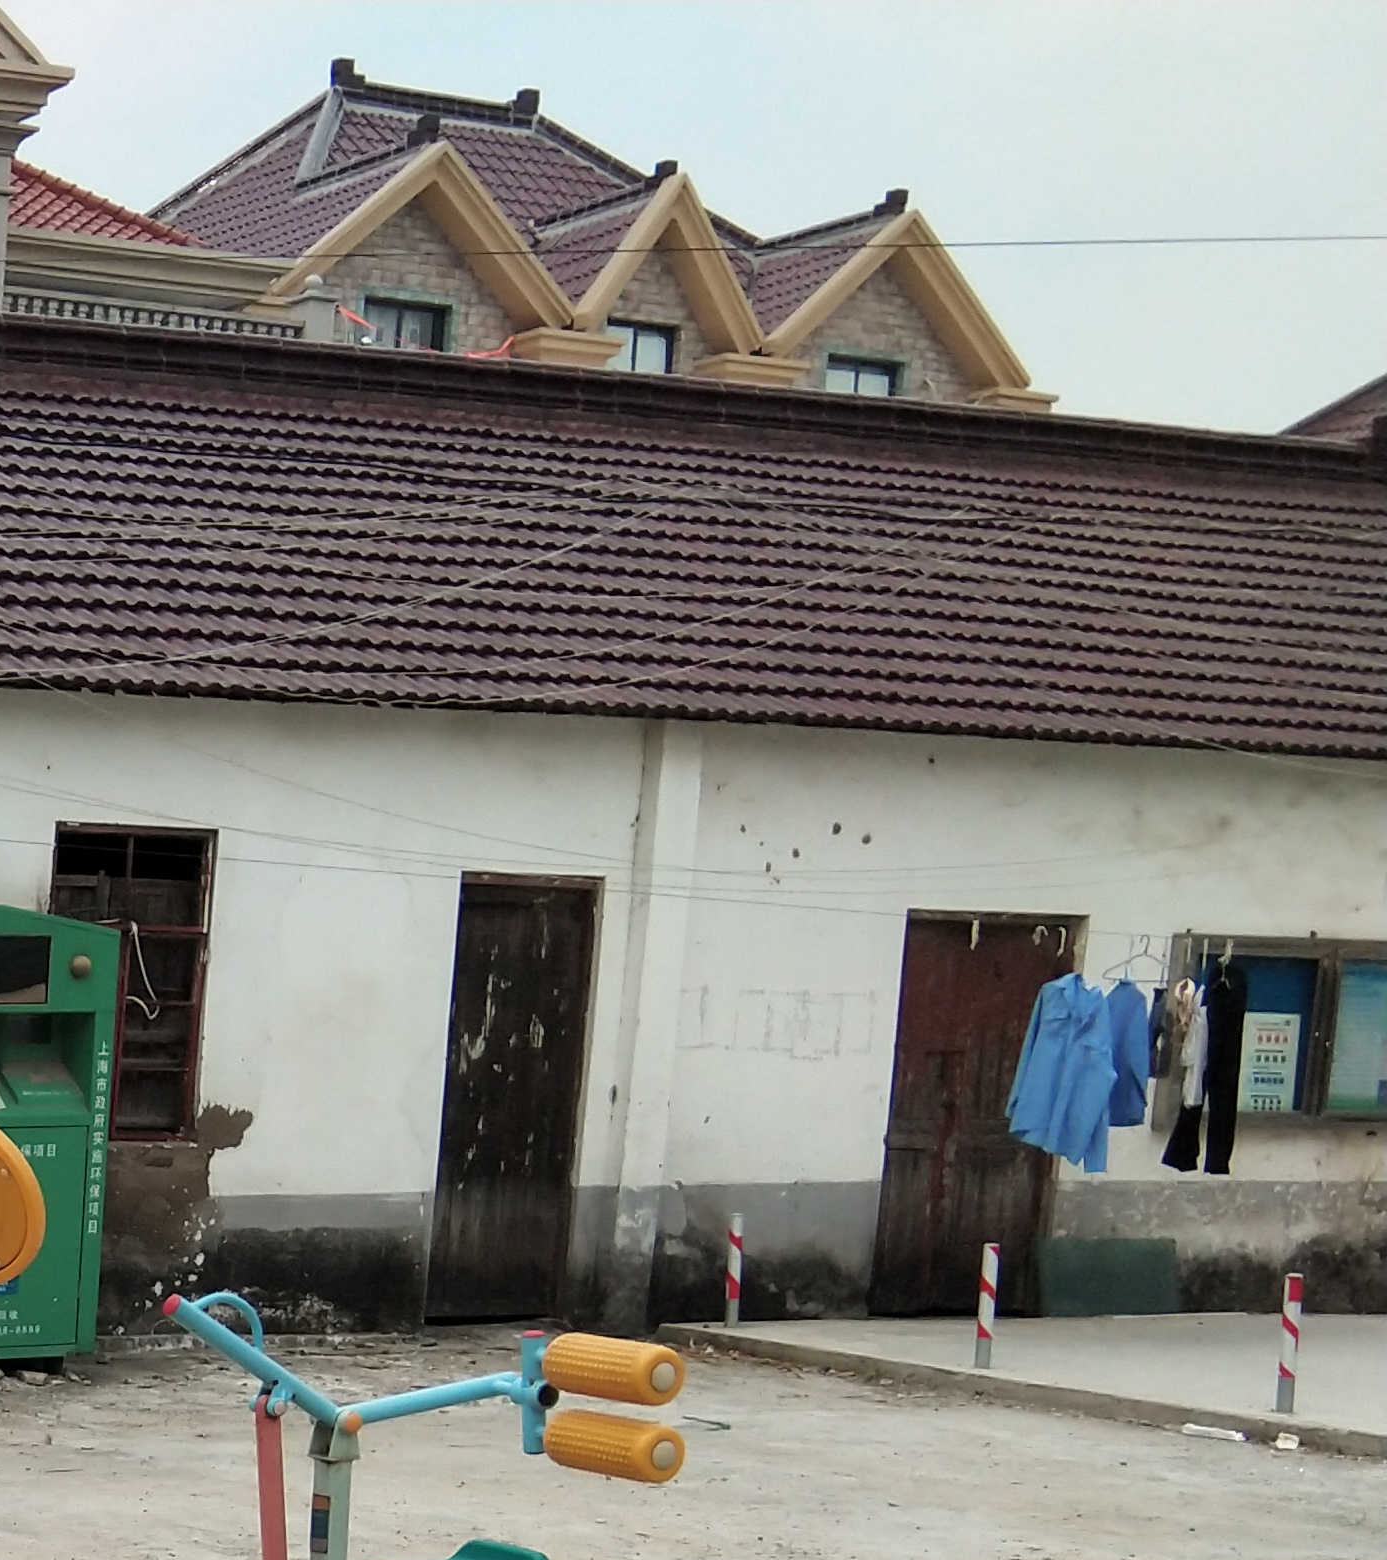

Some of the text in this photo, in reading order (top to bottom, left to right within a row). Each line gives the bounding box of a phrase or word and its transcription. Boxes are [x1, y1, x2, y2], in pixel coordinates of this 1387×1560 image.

[87, 1041, 110, 1235] 上海市政府实施环保项目
